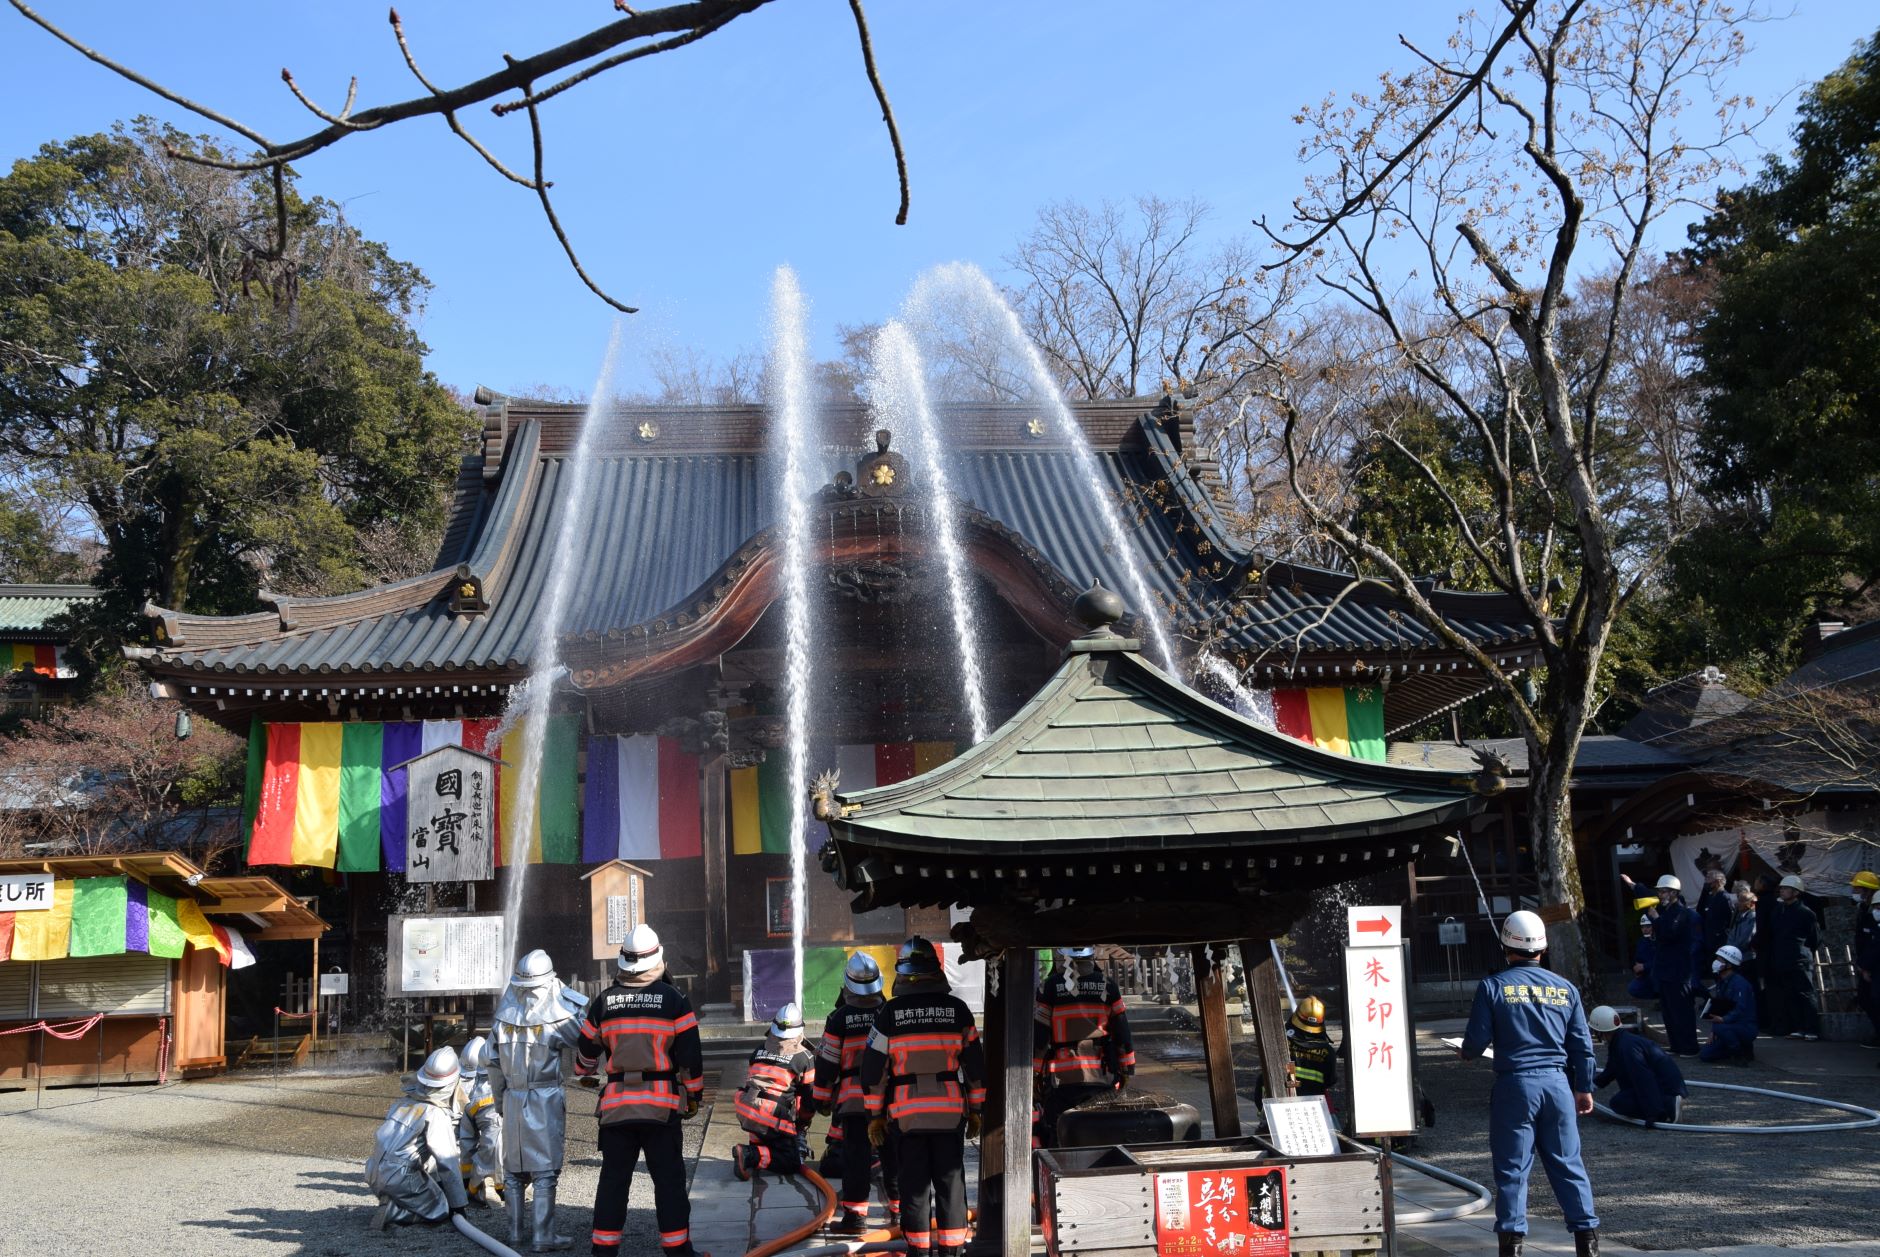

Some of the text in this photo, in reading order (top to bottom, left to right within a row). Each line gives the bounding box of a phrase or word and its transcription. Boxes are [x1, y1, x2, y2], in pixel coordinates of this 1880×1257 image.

[430, 768, 468, 856] 國寶
[412, 826, 430, 870] 當山
[0, 882, 45, 902] し所
[606, 993, 663, 1006] 調布市消防団
[894, 1006, 955, 1020] 調布市消防団
[1363, 956, 1394, 1071] 朱印所
[1503, 985, 1568, 999] 東京消防庁
[1505, 996, 1529, 1004] TOKYO
[1193, 1177, 1222, 1247] 豆まき
[1219, 1176, 1238, 1223] 節分
[1257, 1182, 1274, 1226] 大開帳
